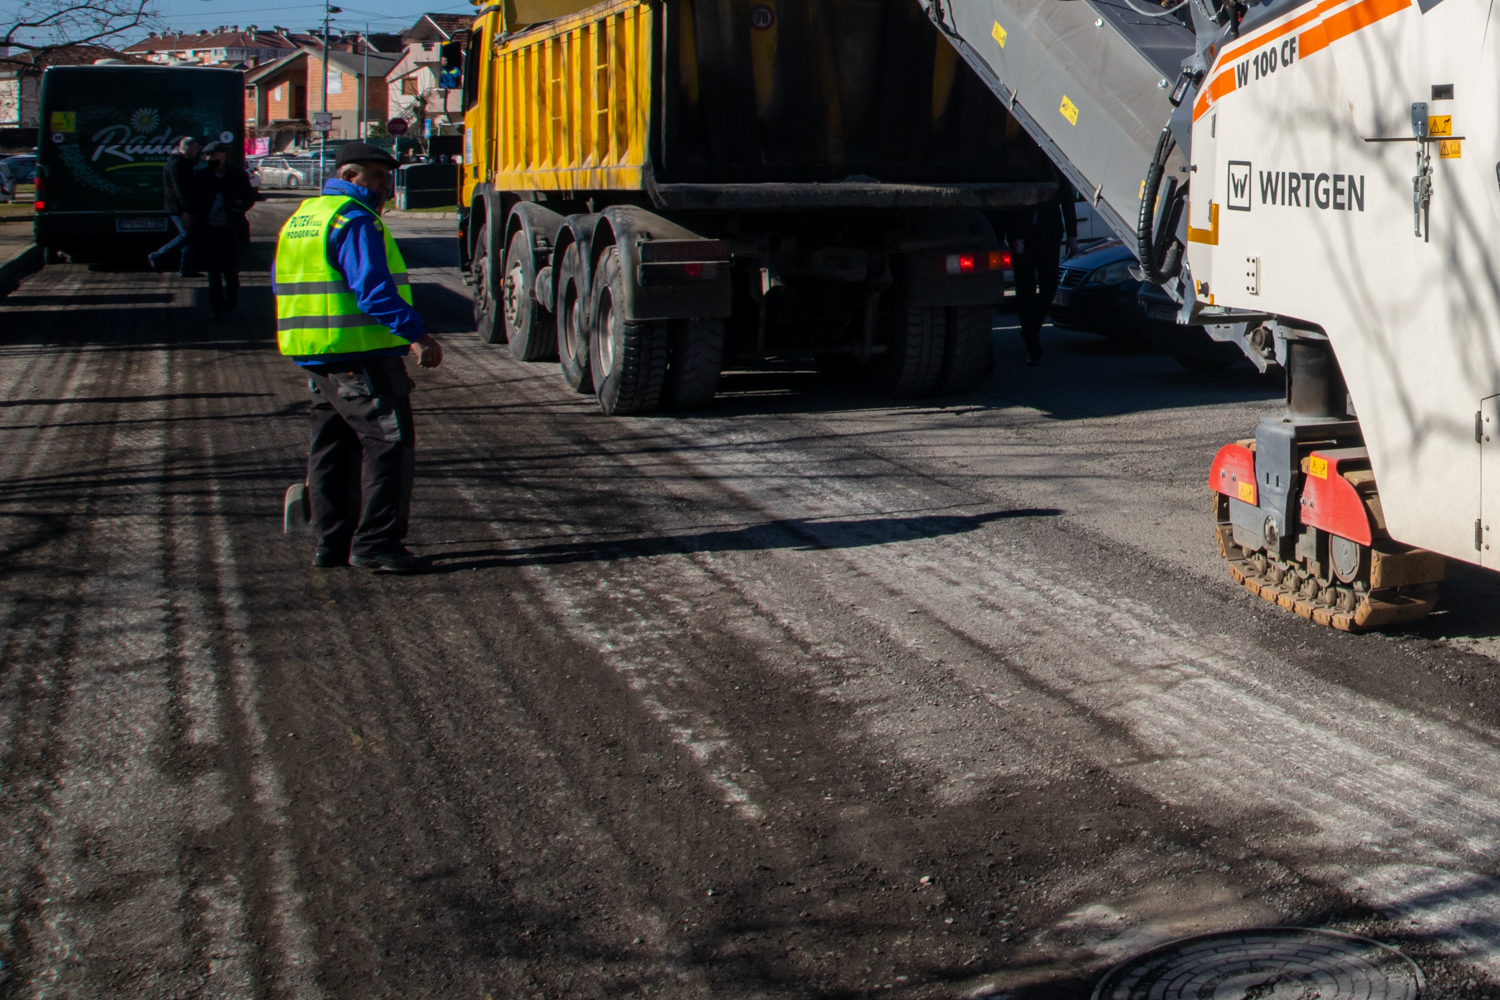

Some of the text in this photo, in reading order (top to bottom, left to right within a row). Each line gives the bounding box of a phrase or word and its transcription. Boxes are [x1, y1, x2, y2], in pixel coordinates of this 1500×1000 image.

[755, 10, 769, 25] 70
[1236, 36, 1297, 89] W 100 CF
[388, 124, 407, 132] STOP
[1258, 170, 1365, 212] WIRTGEN
[289, 214, 316, 228] PUTEVI
[287, 229, 319, 239] PODGORICA
[653, 246, 672, 260] PG
